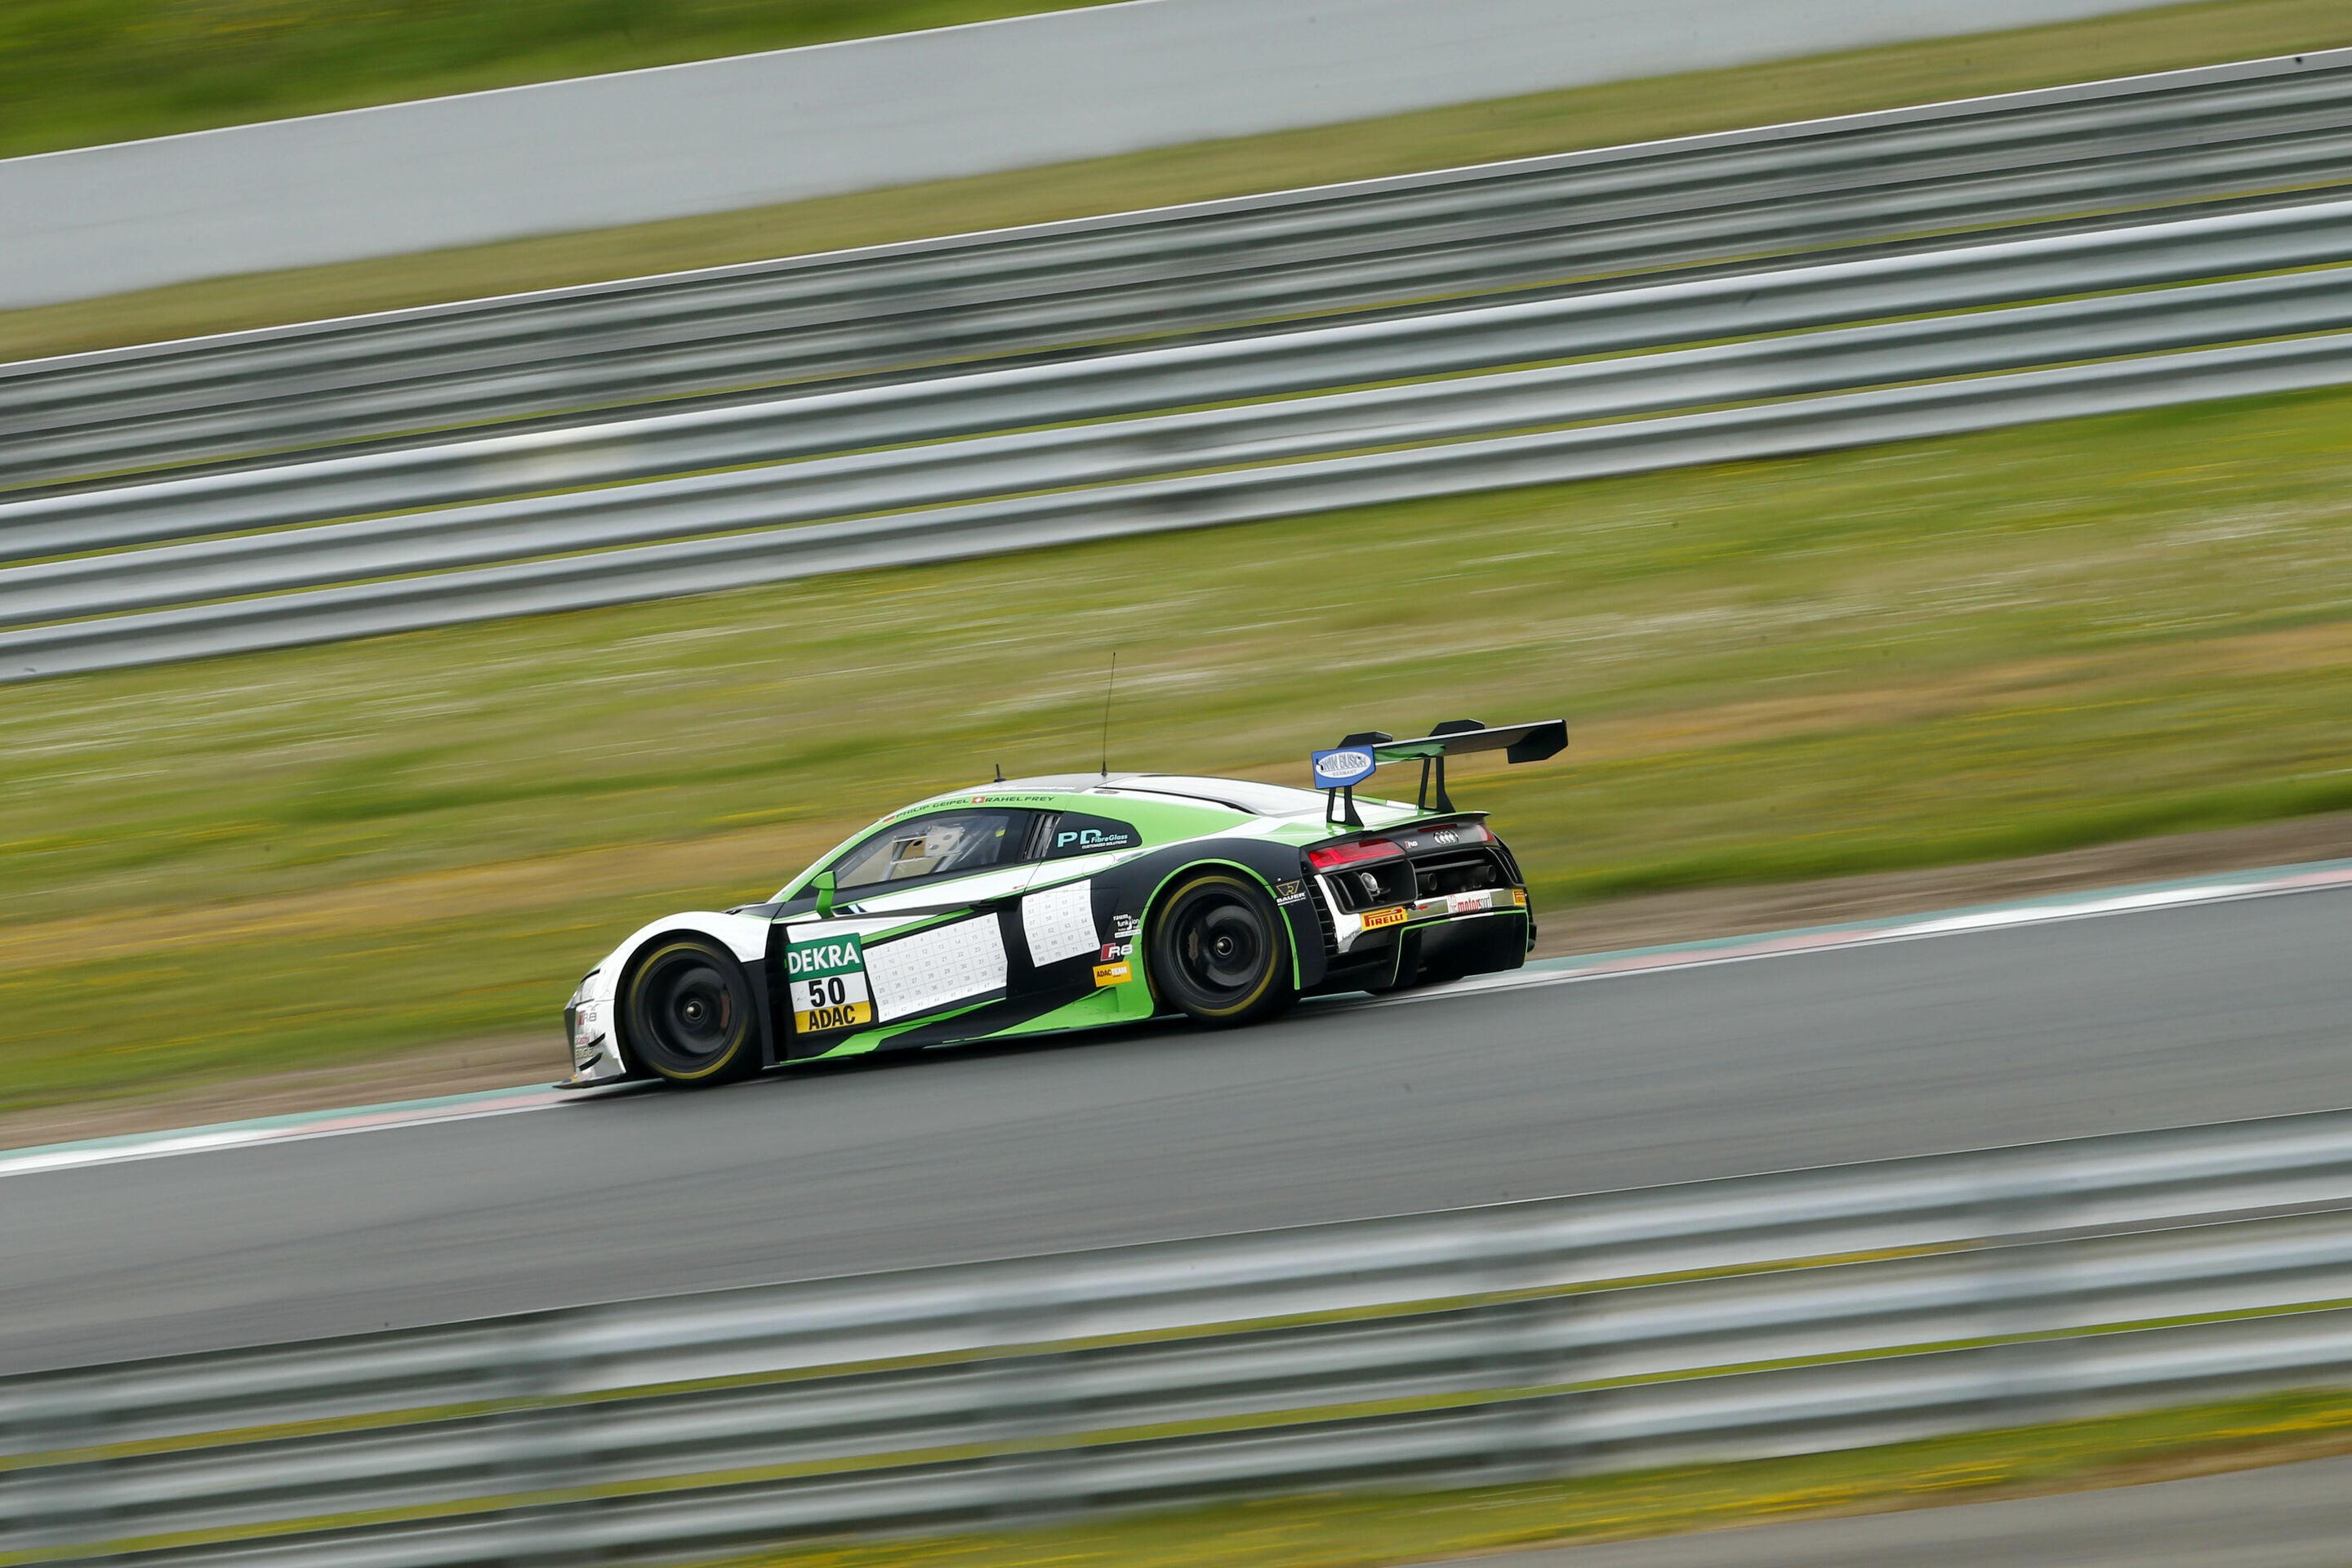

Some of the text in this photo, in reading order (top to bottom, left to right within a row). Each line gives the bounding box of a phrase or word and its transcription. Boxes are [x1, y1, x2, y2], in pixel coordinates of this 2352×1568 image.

[1339, 753, 1367, 768] BUSCH
[896, 799, 969, 818] PHILIP GEIPEL
[1091, 834, 1128, 844] FibreGlass
[1276, 891, 1306, 903] BAUER
[1364, 908, 1403, 927] PIRELLI
[787, 942, 860, 974] DEKRA
[1107, 943, 1133, 959] R8
[1097, 969, 1111, 978] ADAC
[808, 977, 845, 1007] 50
[809, 1005, 855, 1030] ADAC
